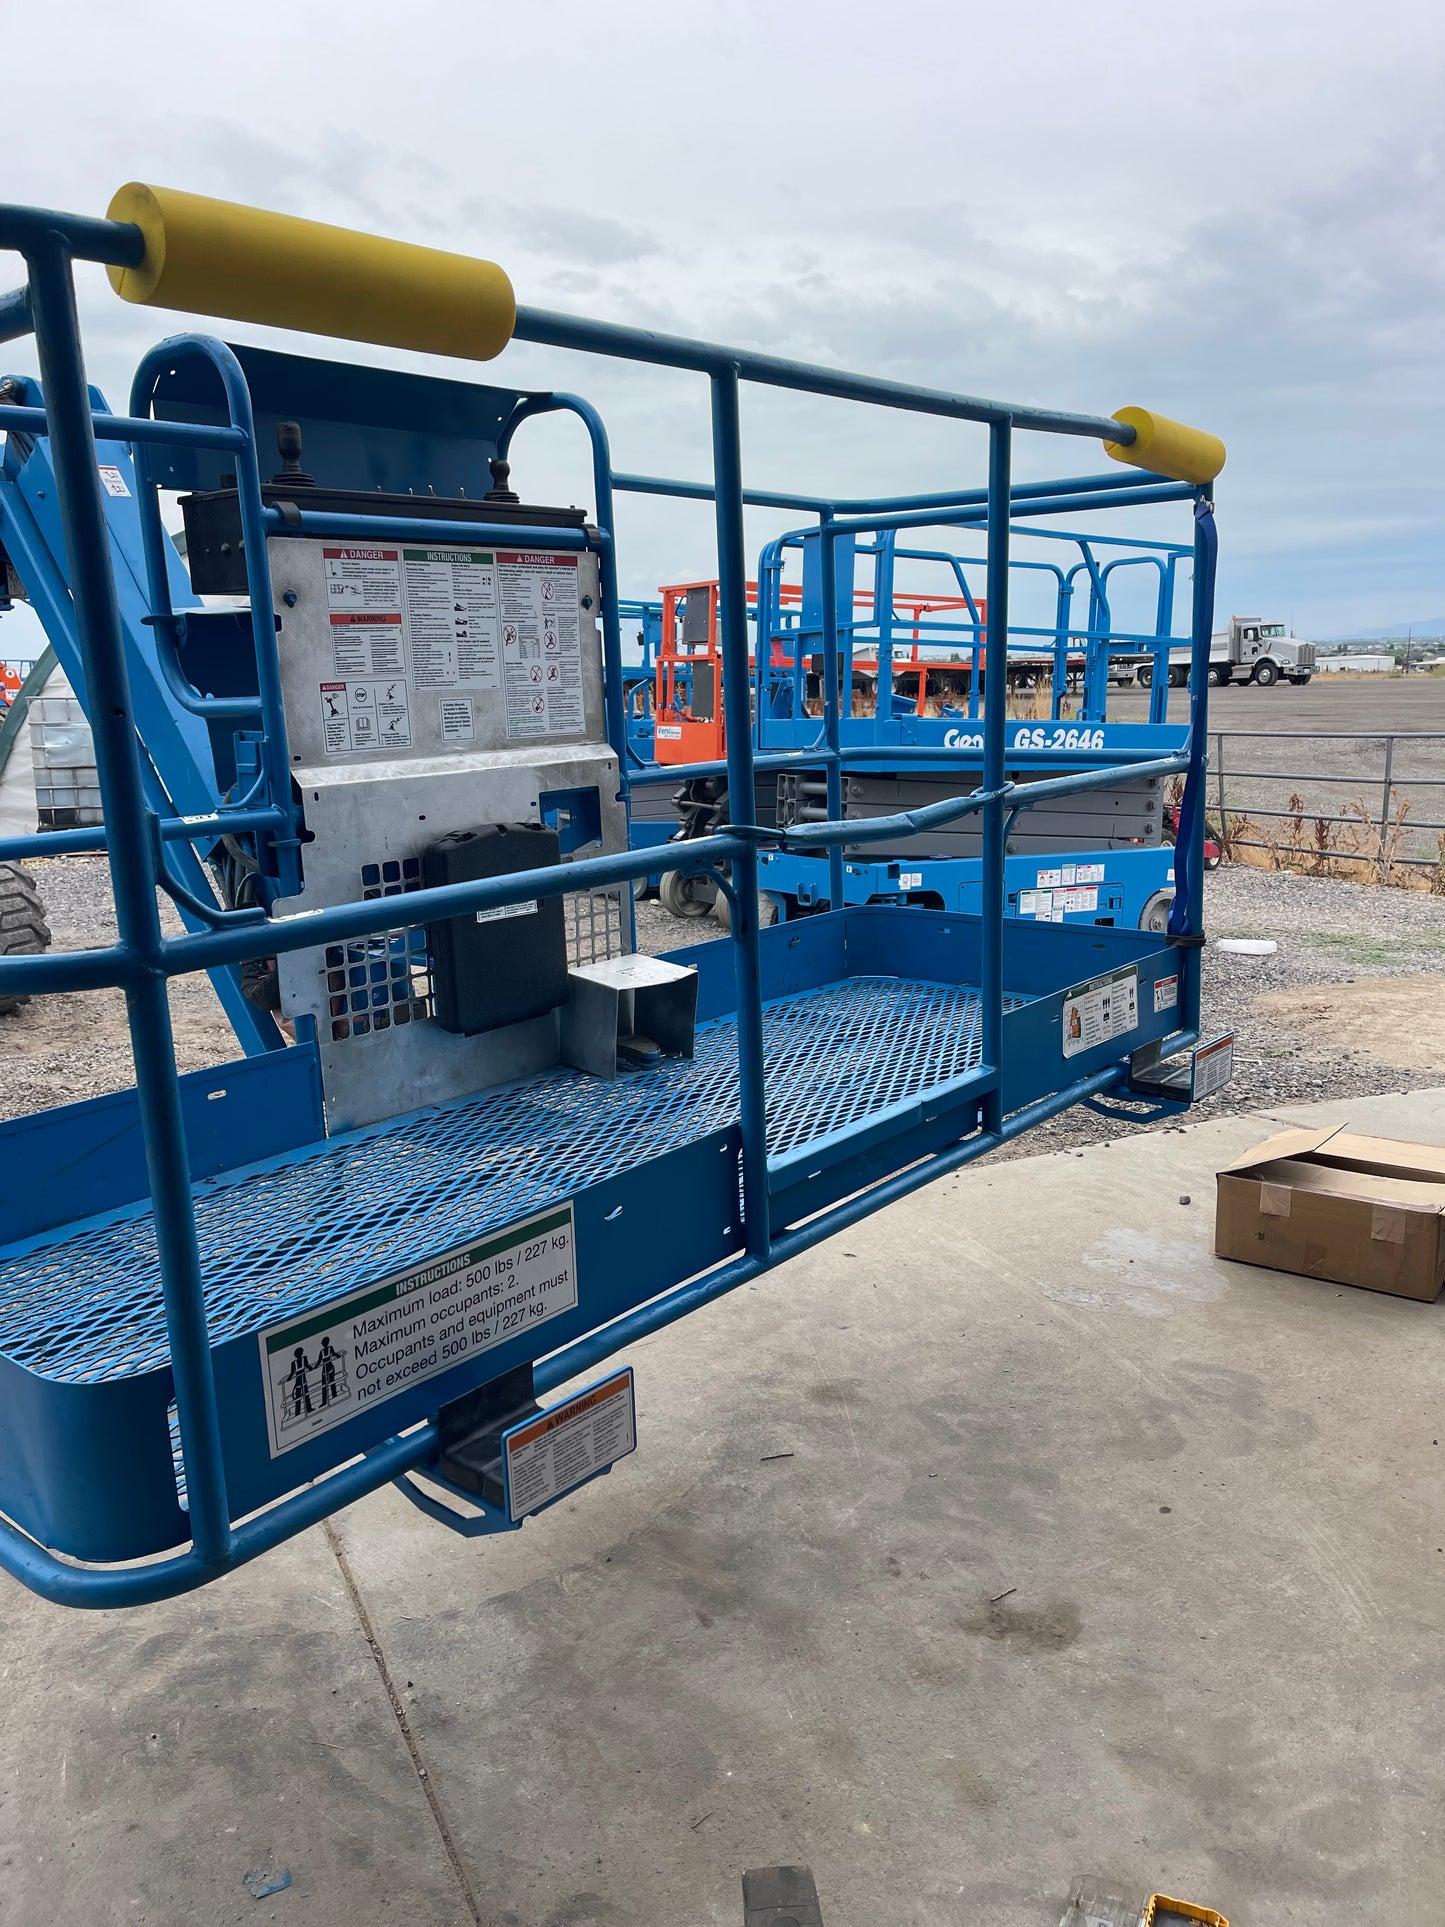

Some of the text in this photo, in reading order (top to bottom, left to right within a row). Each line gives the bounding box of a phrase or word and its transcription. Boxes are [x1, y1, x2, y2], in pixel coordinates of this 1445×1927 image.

[349, 550, 384, 559] DANGER
[426, 551, 472, 562] INSTRUCTIONS
[524, 555, 555, 564] DANGER
[356, 615, 386, 623] WARNING
[1014, 728, 1105, 749] GS-2646
[353, 1235, 569, 1339] Maximum load: 500 lbs / 227 kg.
[395, 1253, 471, 1296] INSTRUCTIONS
[354, 1274, 519, 1360] Maximum occupants: 2.
[356, 1269, 569, 1379] Occupants and equipment must
[357, 1302, 547, 1400] not exceed 500 lbs / 227 kg.
[554, 1394, 598, 1425] WARNING
